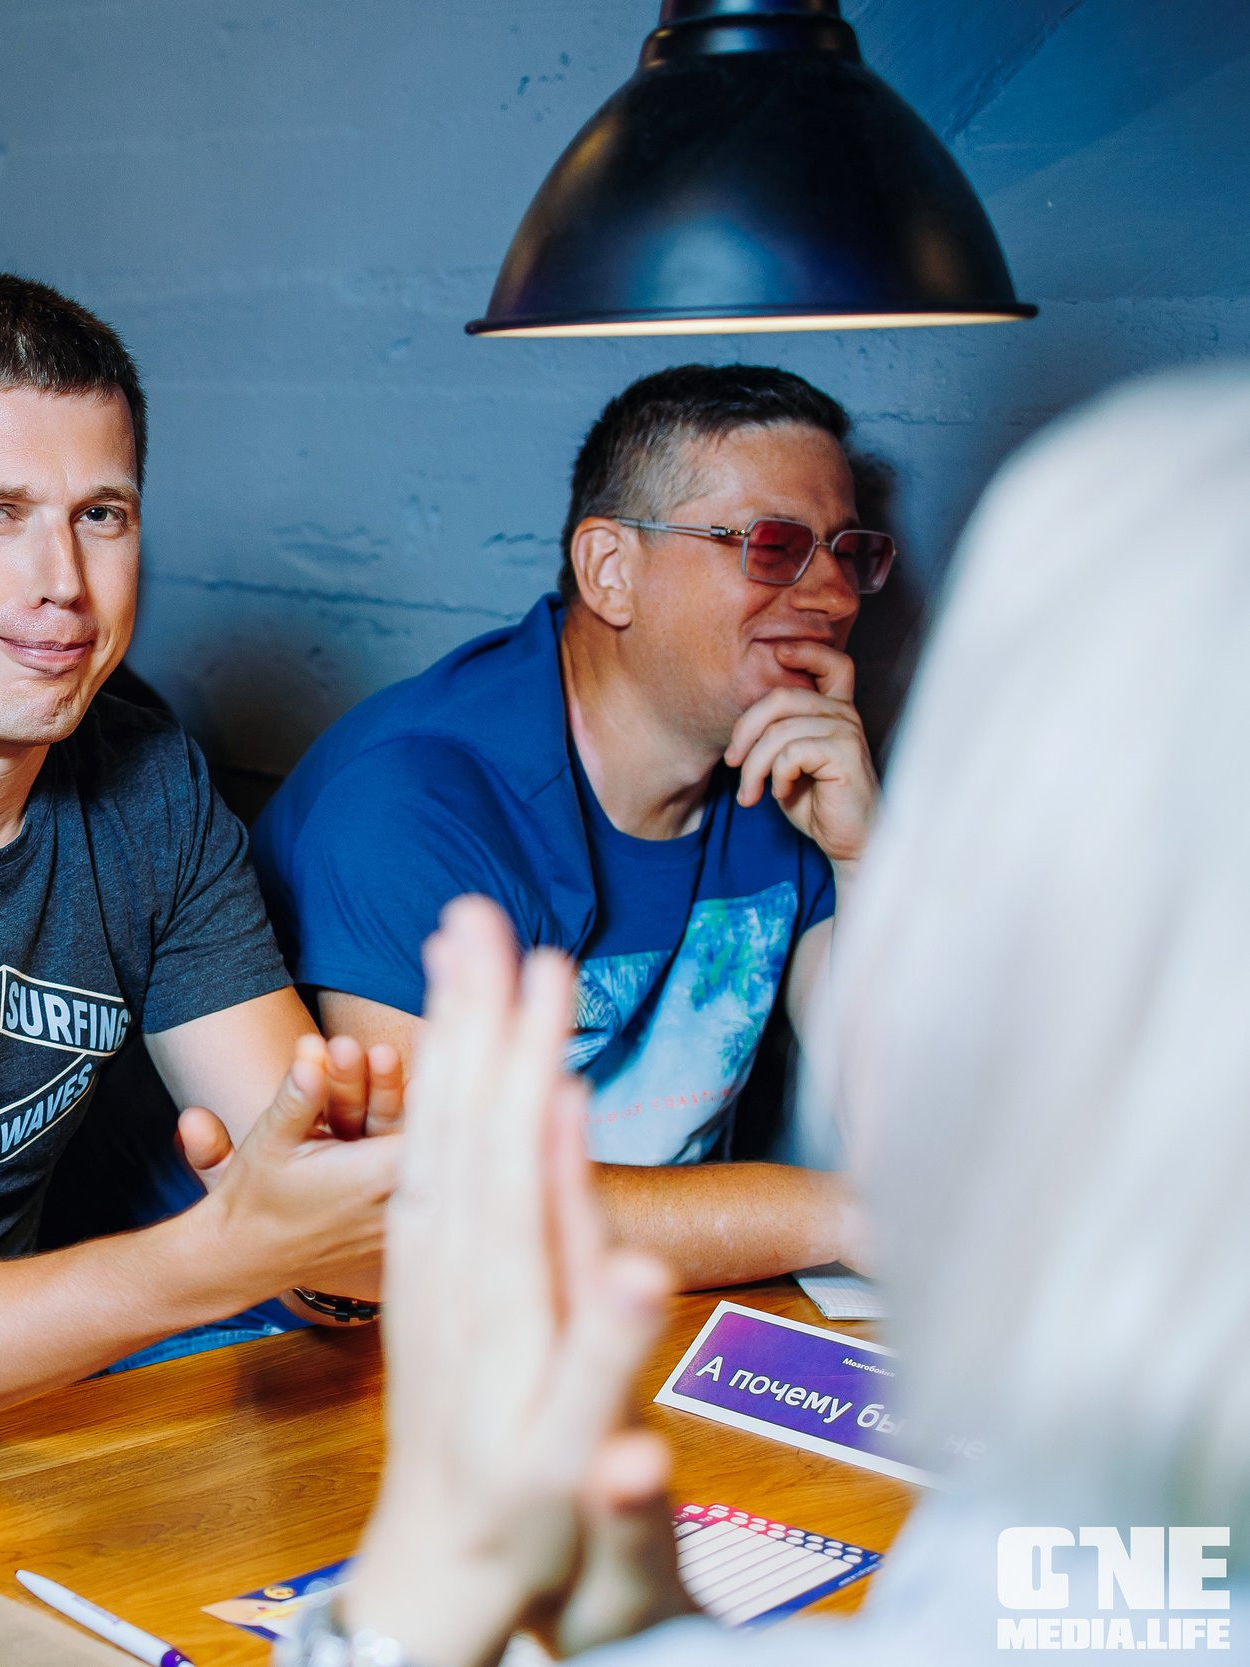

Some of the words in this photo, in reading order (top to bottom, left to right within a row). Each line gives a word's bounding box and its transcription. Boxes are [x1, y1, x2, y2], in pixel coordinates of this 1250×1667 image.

[6, 981, 128, 1050] SURFING
[1, 1063, 92, 1153] WAVES
[695, 1356, 724, 1382] А
[728, 1369, 853, 1424] почему
[856, 1403, 907, 1437] бы
